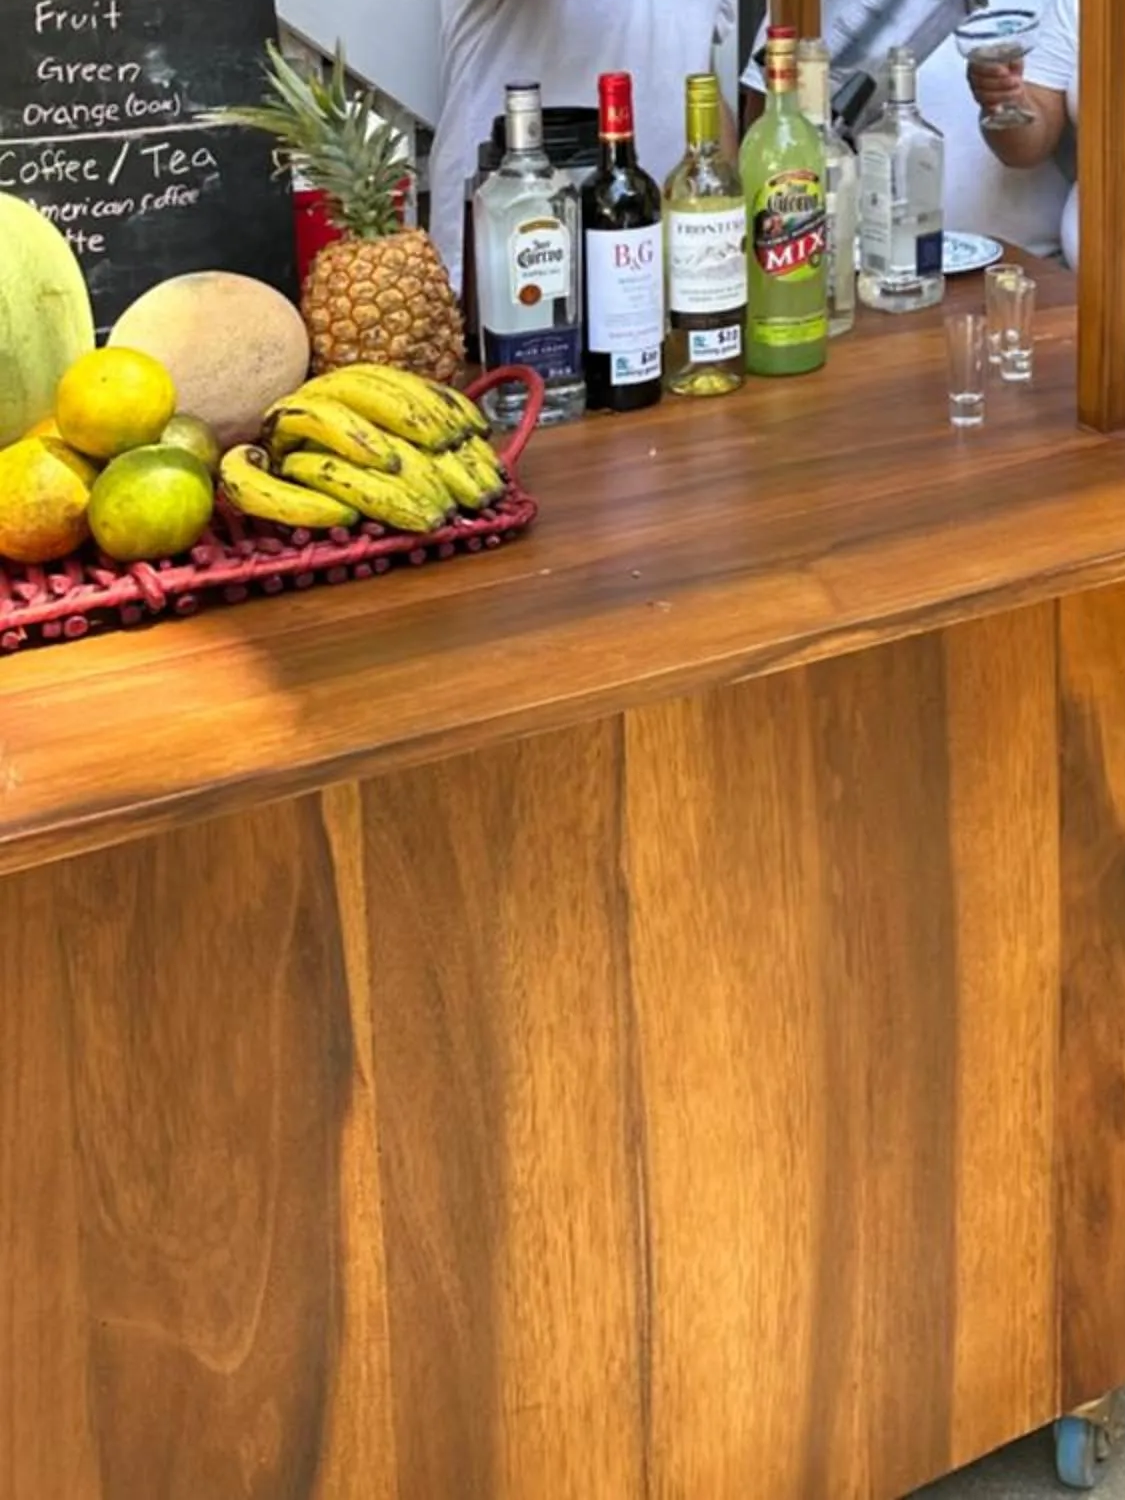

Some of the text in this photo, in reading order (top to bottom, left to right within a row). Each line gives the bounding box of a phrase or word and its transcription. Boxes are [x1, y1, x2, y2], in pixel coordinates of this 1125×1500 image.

[35, 0, 122, 34] Fruit
[38, 57, 141, 84] Green
[0, 149, 99, 186] Coffee
[140, 143, 217, 177] Tea
[614, 239, 653, 271] B&G
[766, 226, 825, 270] MIX
